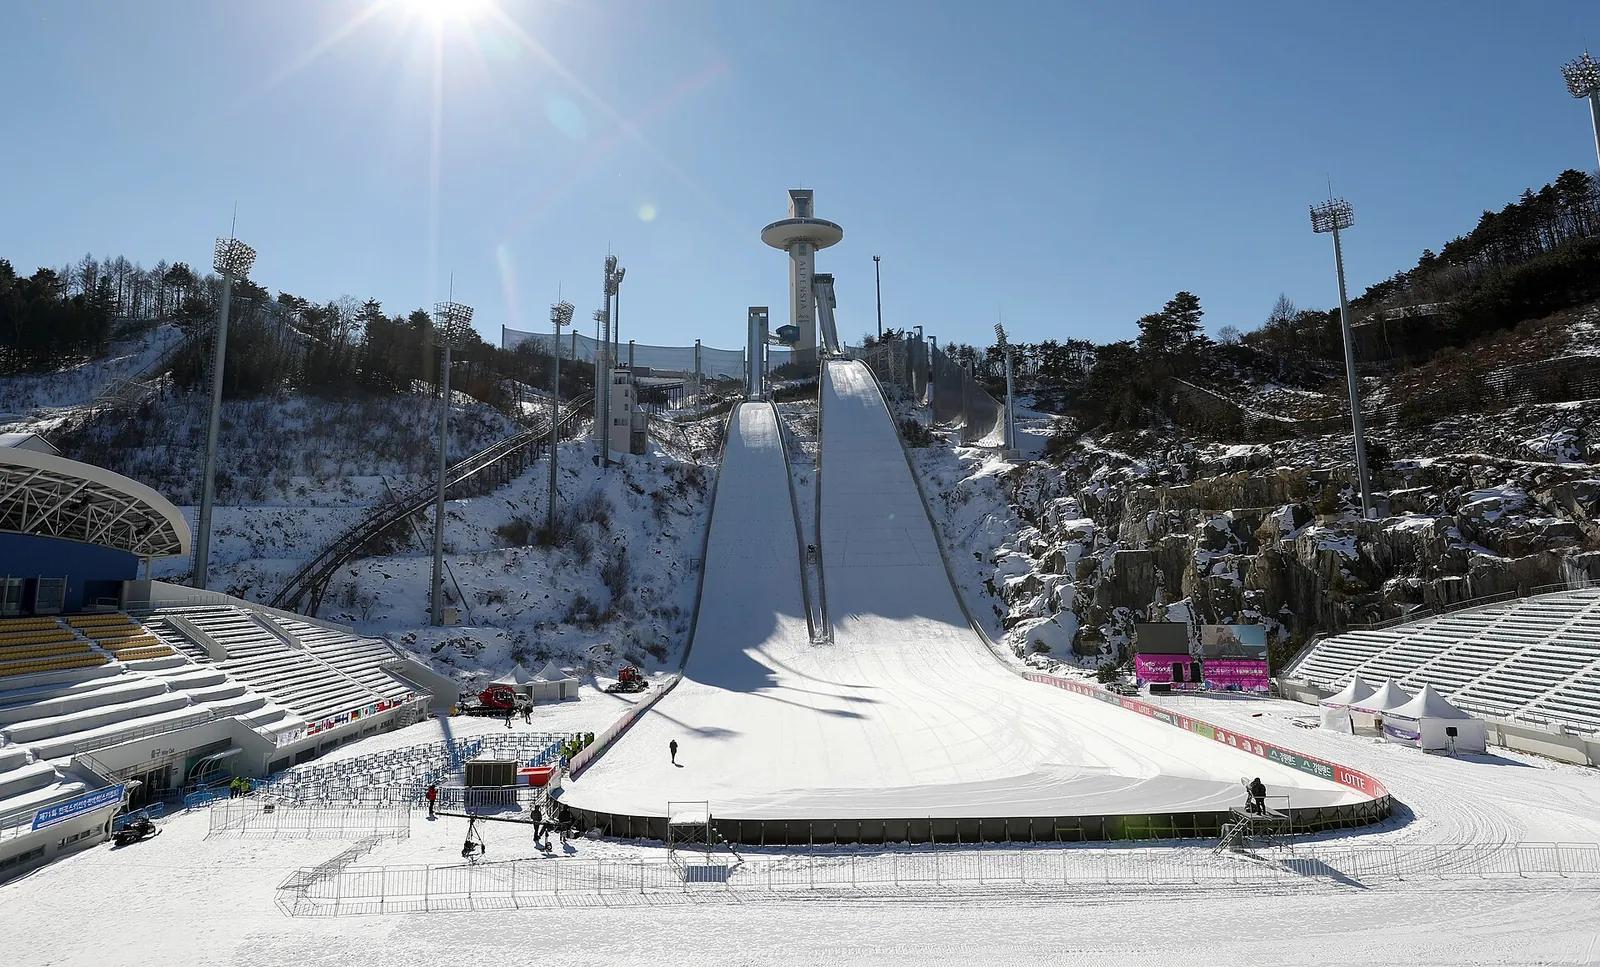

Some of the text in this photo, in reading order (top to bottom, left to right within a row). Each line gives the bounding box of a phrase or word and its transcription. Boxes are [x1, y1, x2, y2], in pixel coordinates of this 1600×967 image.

[1123, 700, 1135, 711] LOTTE
[1138, 705, 1151, 716] LOTTE
[1279, 751, 1297, 766] 강원랜드
[1312, 761, 1332, 777] 강원랜드
[1340, 771, 1366, 790] LOTTE
